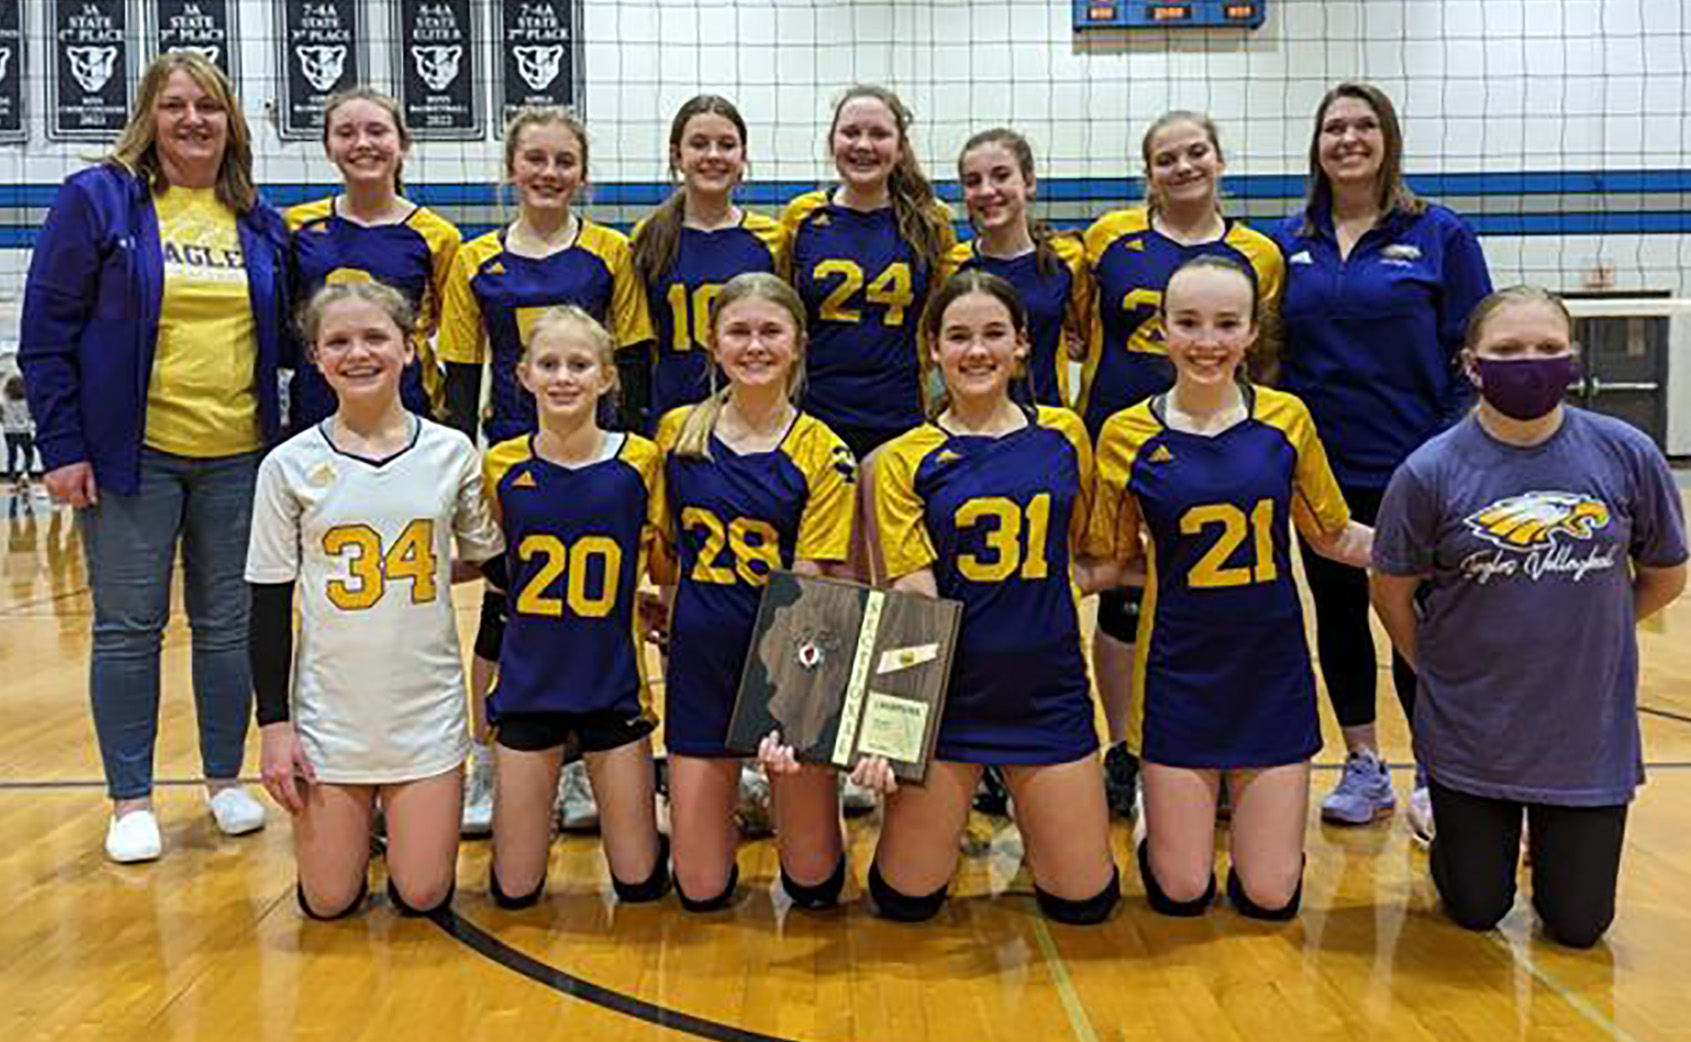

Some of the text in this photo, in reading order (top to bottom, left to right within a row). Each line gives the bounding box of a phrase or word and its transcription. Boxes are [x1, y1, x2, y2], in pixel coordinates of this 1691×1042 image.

[69, 17, 112, 28] STATE
[170, 16, 213, 28] STATE
[302, 18, 340, 28] STATE
[416, 18, 456, 28] STATE
[517, 18, 558, 28] STATE
[80, 30, 124, 41] PLACE
[180, 29, 224, 41] PLACE
[309, 29, 351, 41] PLACE
[526, 29, 570, 40] PLACE
[163, 241, 245, 269] AGLE
[813, 259, 913, 326] 24
[1123, 288, 1170, 353] 2
[954, 493, 1051, 582] 31
[1179, 498, 1277, 587] 21
[681, 507, 783, 586] 28
[323, 518, 437, 611] 34
[517, 534, 621, 617] 20
